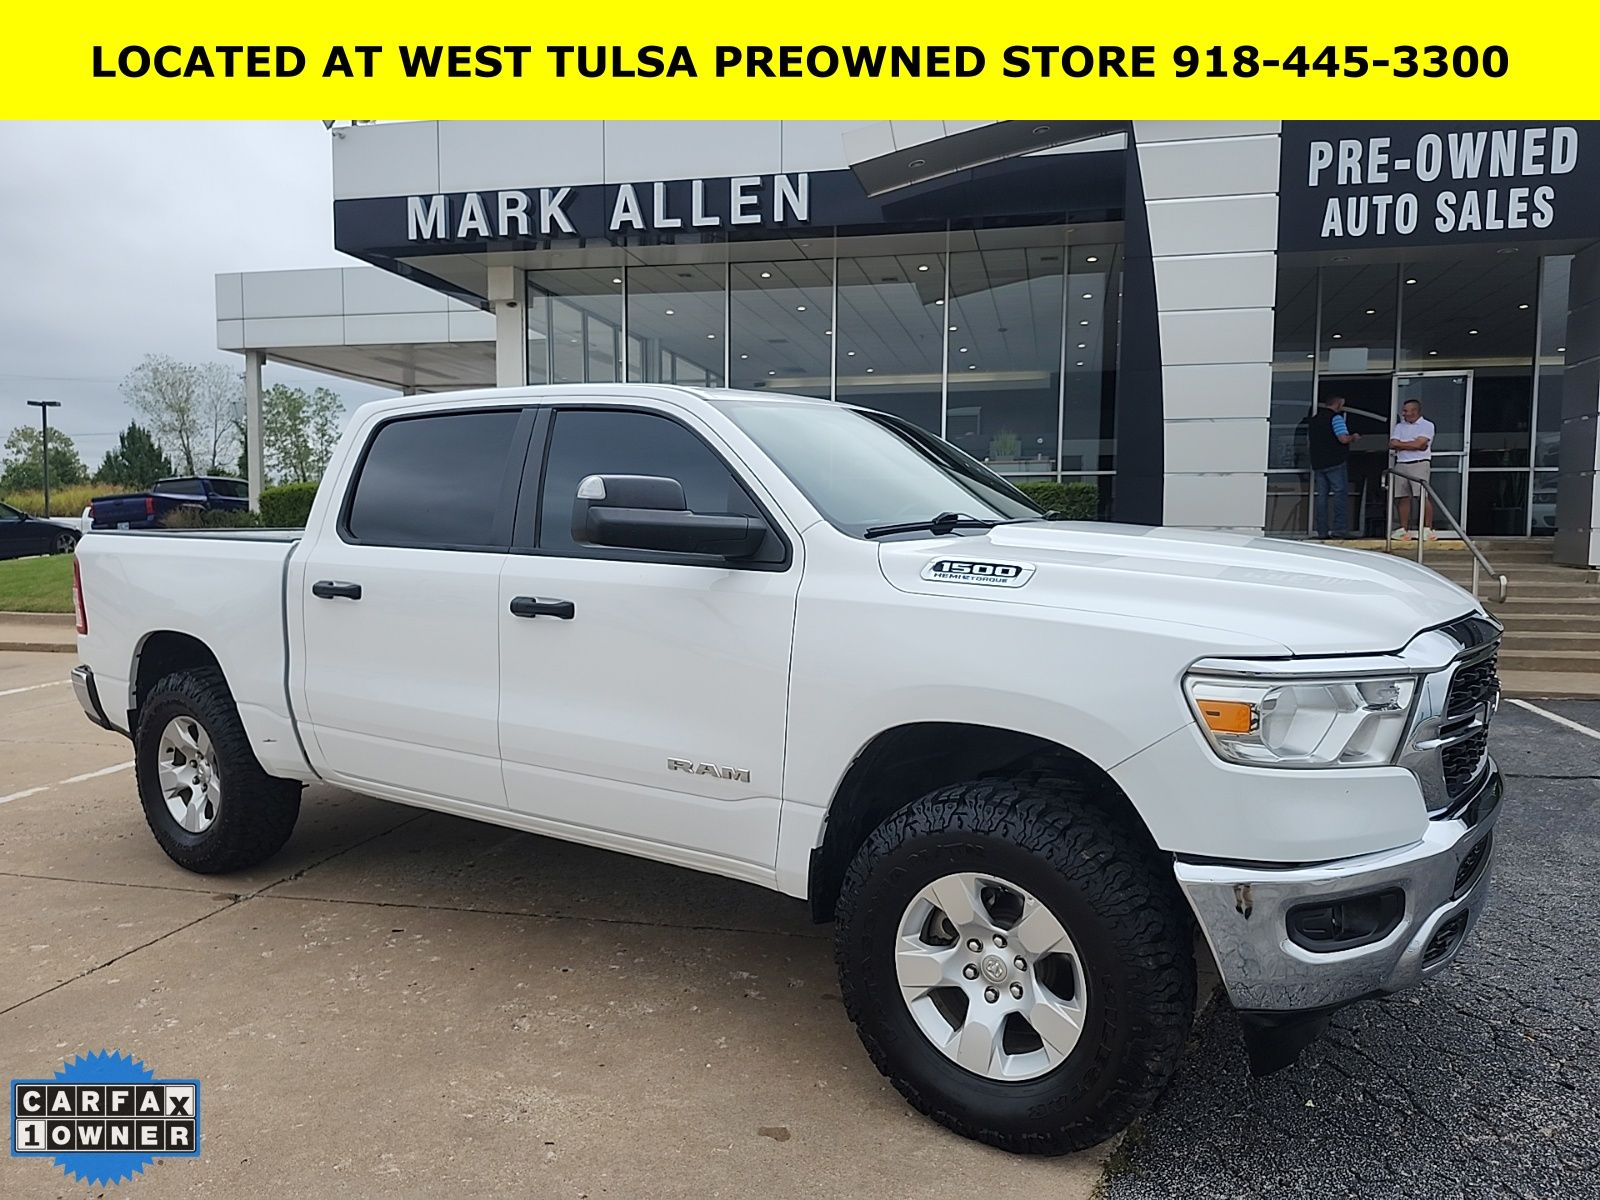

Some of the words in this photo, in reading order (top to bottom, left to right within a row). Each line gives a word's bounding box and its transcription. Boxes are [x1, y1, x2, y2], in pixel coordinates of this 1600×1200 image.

[1308, 126, 1579, 187] PRE-OWNED
[406, 187, 577, 241] MARK
[609, 172, 809, 231] ALLEN
[1320, 192, 1418, 238] AUTO
[1434, 185, 1555, 233] SALES
[940, 561, 1017, 577] 1500
[667, 757, 750, 783] RAM
